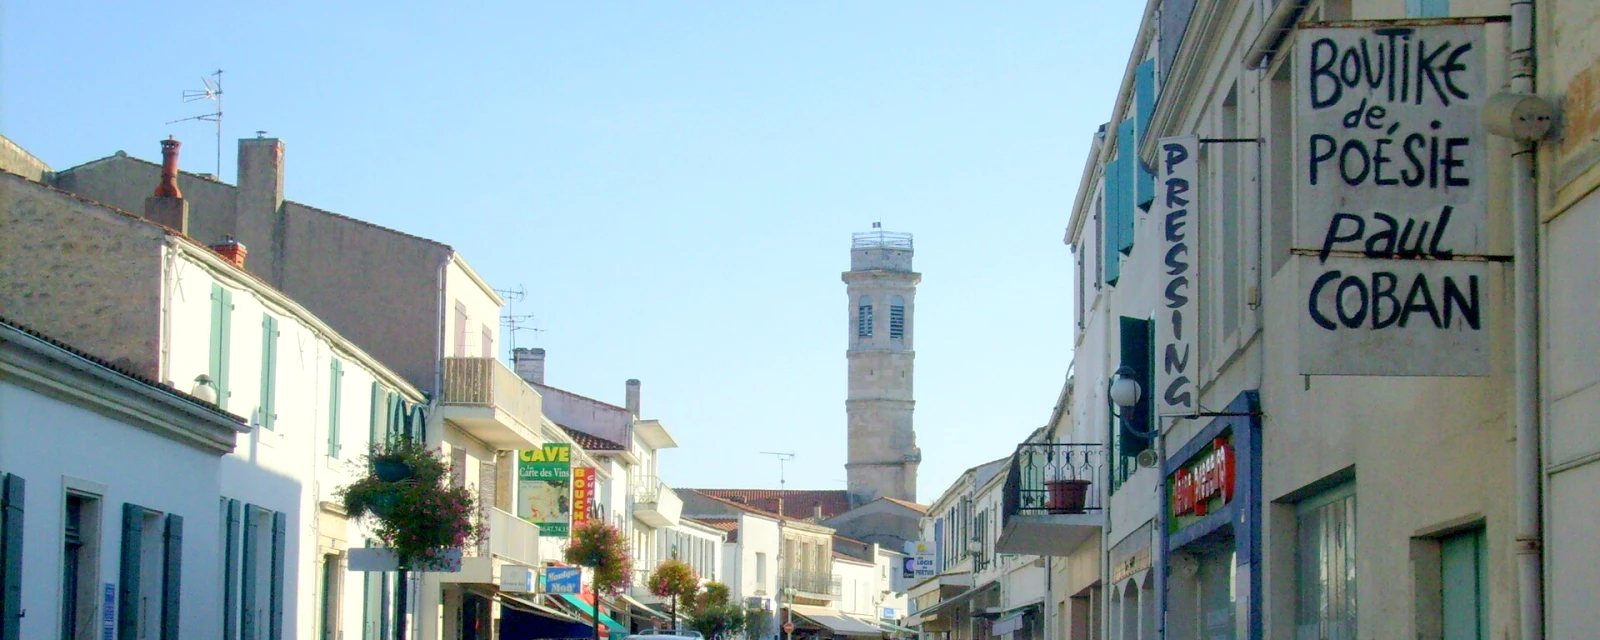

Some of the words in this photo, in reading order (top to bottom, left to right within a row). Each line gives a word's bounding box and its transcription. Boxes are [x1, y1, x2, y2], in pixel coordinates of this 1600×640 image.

[1343, 101, 1386, 131] de
[1163, 143, 1190, 408] PRESSING
[1308, 270, 1481, 331] COBAN
[519, 447, 569, 462] CAVE
[519, 467, 539, 477] Carte
[540, 467, 553, 477] des
[553, 467, 570, 477] Vins
[574, 468, 585, 520] BOUCH
